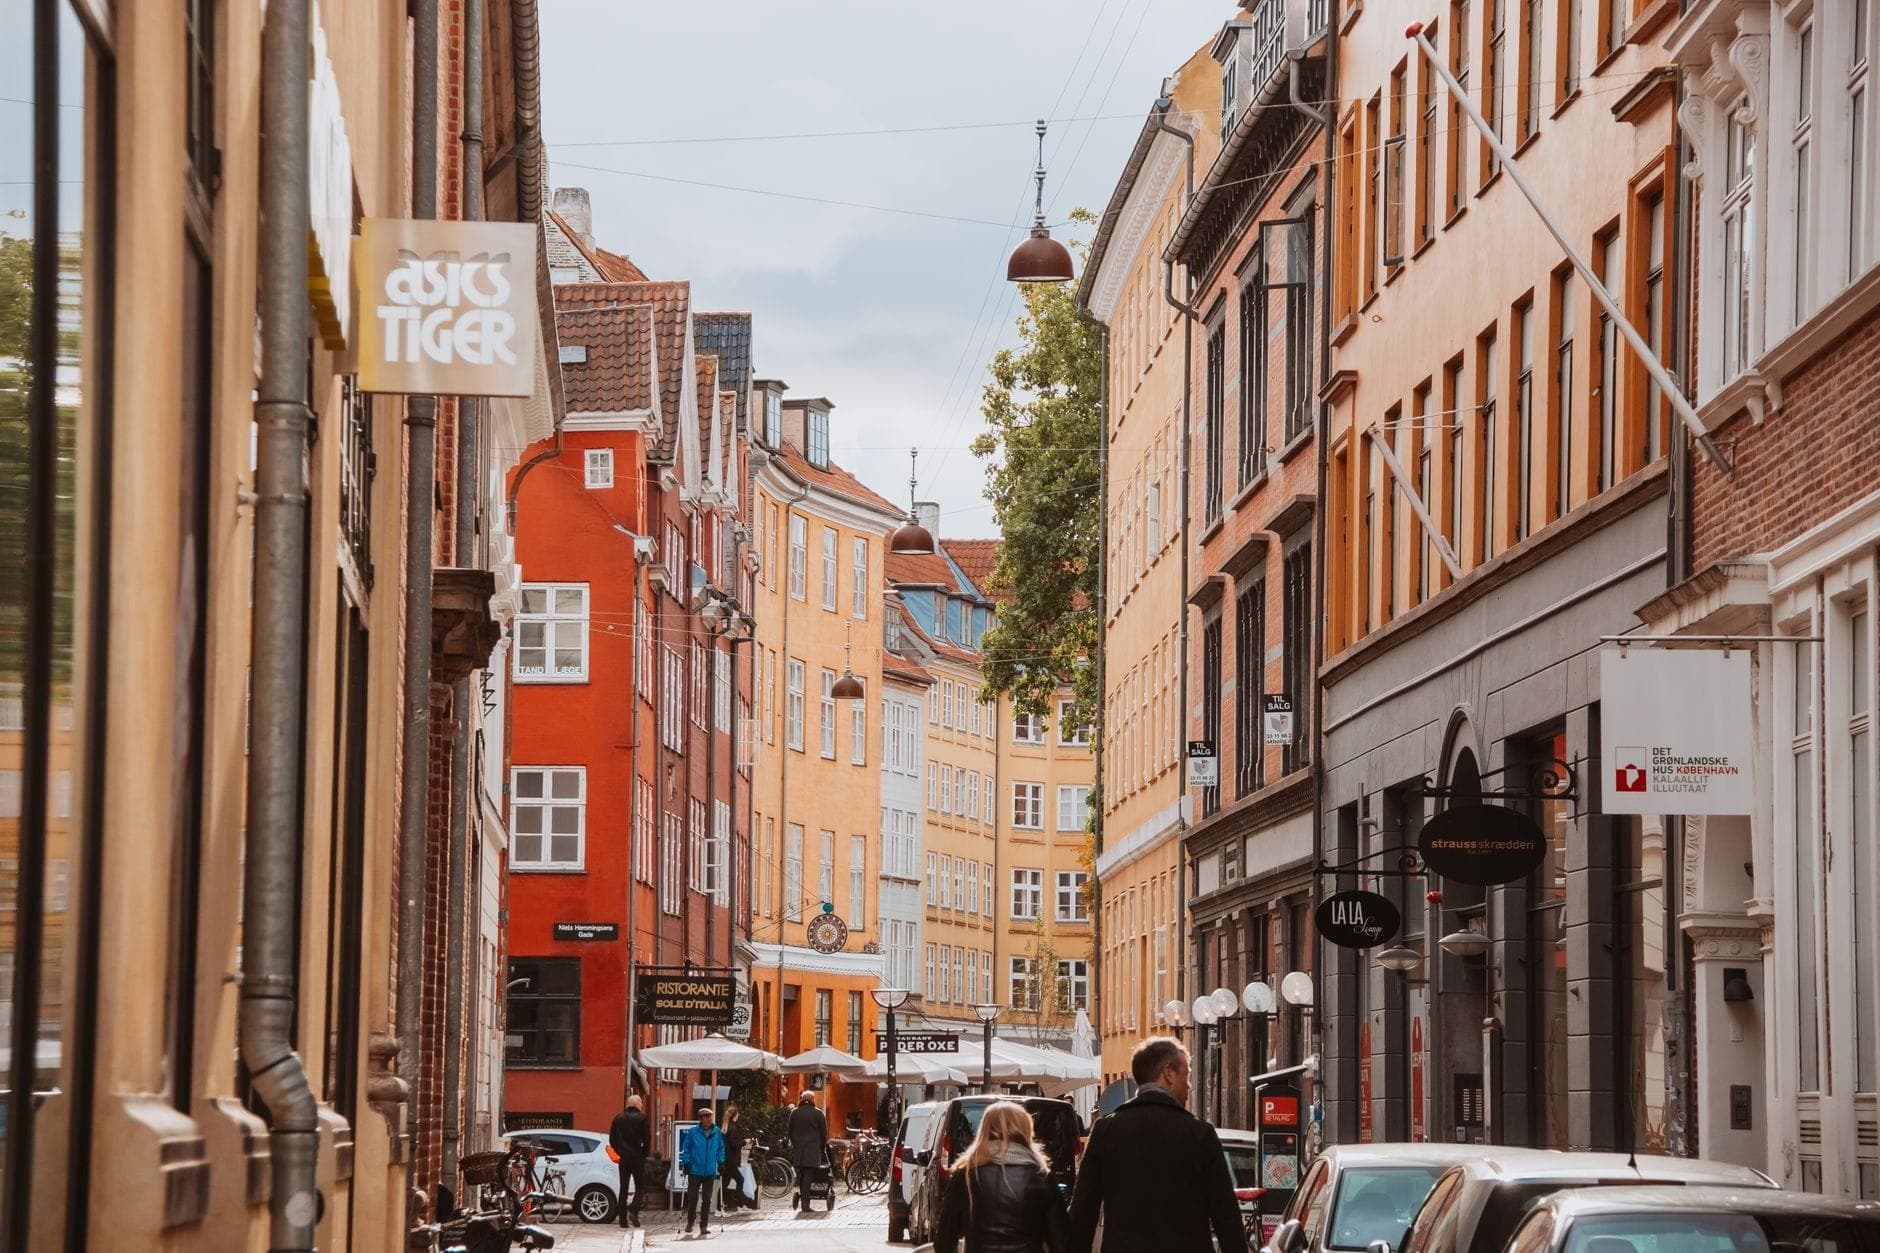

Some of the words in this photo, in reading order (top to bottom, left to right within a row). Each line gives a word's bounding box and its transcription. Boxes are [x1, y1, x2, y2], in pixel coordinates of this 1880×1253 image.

[377, 305, 517, 365] TIGER
[1653, 747, 1672, 755] DET
[1653, 757, 1729, 765] GRØNLANDSKE
[1653, 766, 1673, 774] HUS
[1676, 766, 1738, 775] KØBENHAVN
[1653, 775, 1709, 783] KALAALLIT
[1653, 784, 1708, 792] ILLUUTAAT
[1431, 839, 1476, 848] strauss
[1478, 839, 1534, 849] skrædderi
[1331, 900, 1347, 925] LA
[1348, 900, 1364, 925] LA
[656, 982, 730, 996] RISTORANTE
[656, 999, 683, 1008] SOLE
[685, 998, 728, 1010] D'ITALIA
[879, 1041, 925, 1051] PDER
[927, 1041, 956, 1051] OXE
[1265, 1101, 1275, 1114] P
